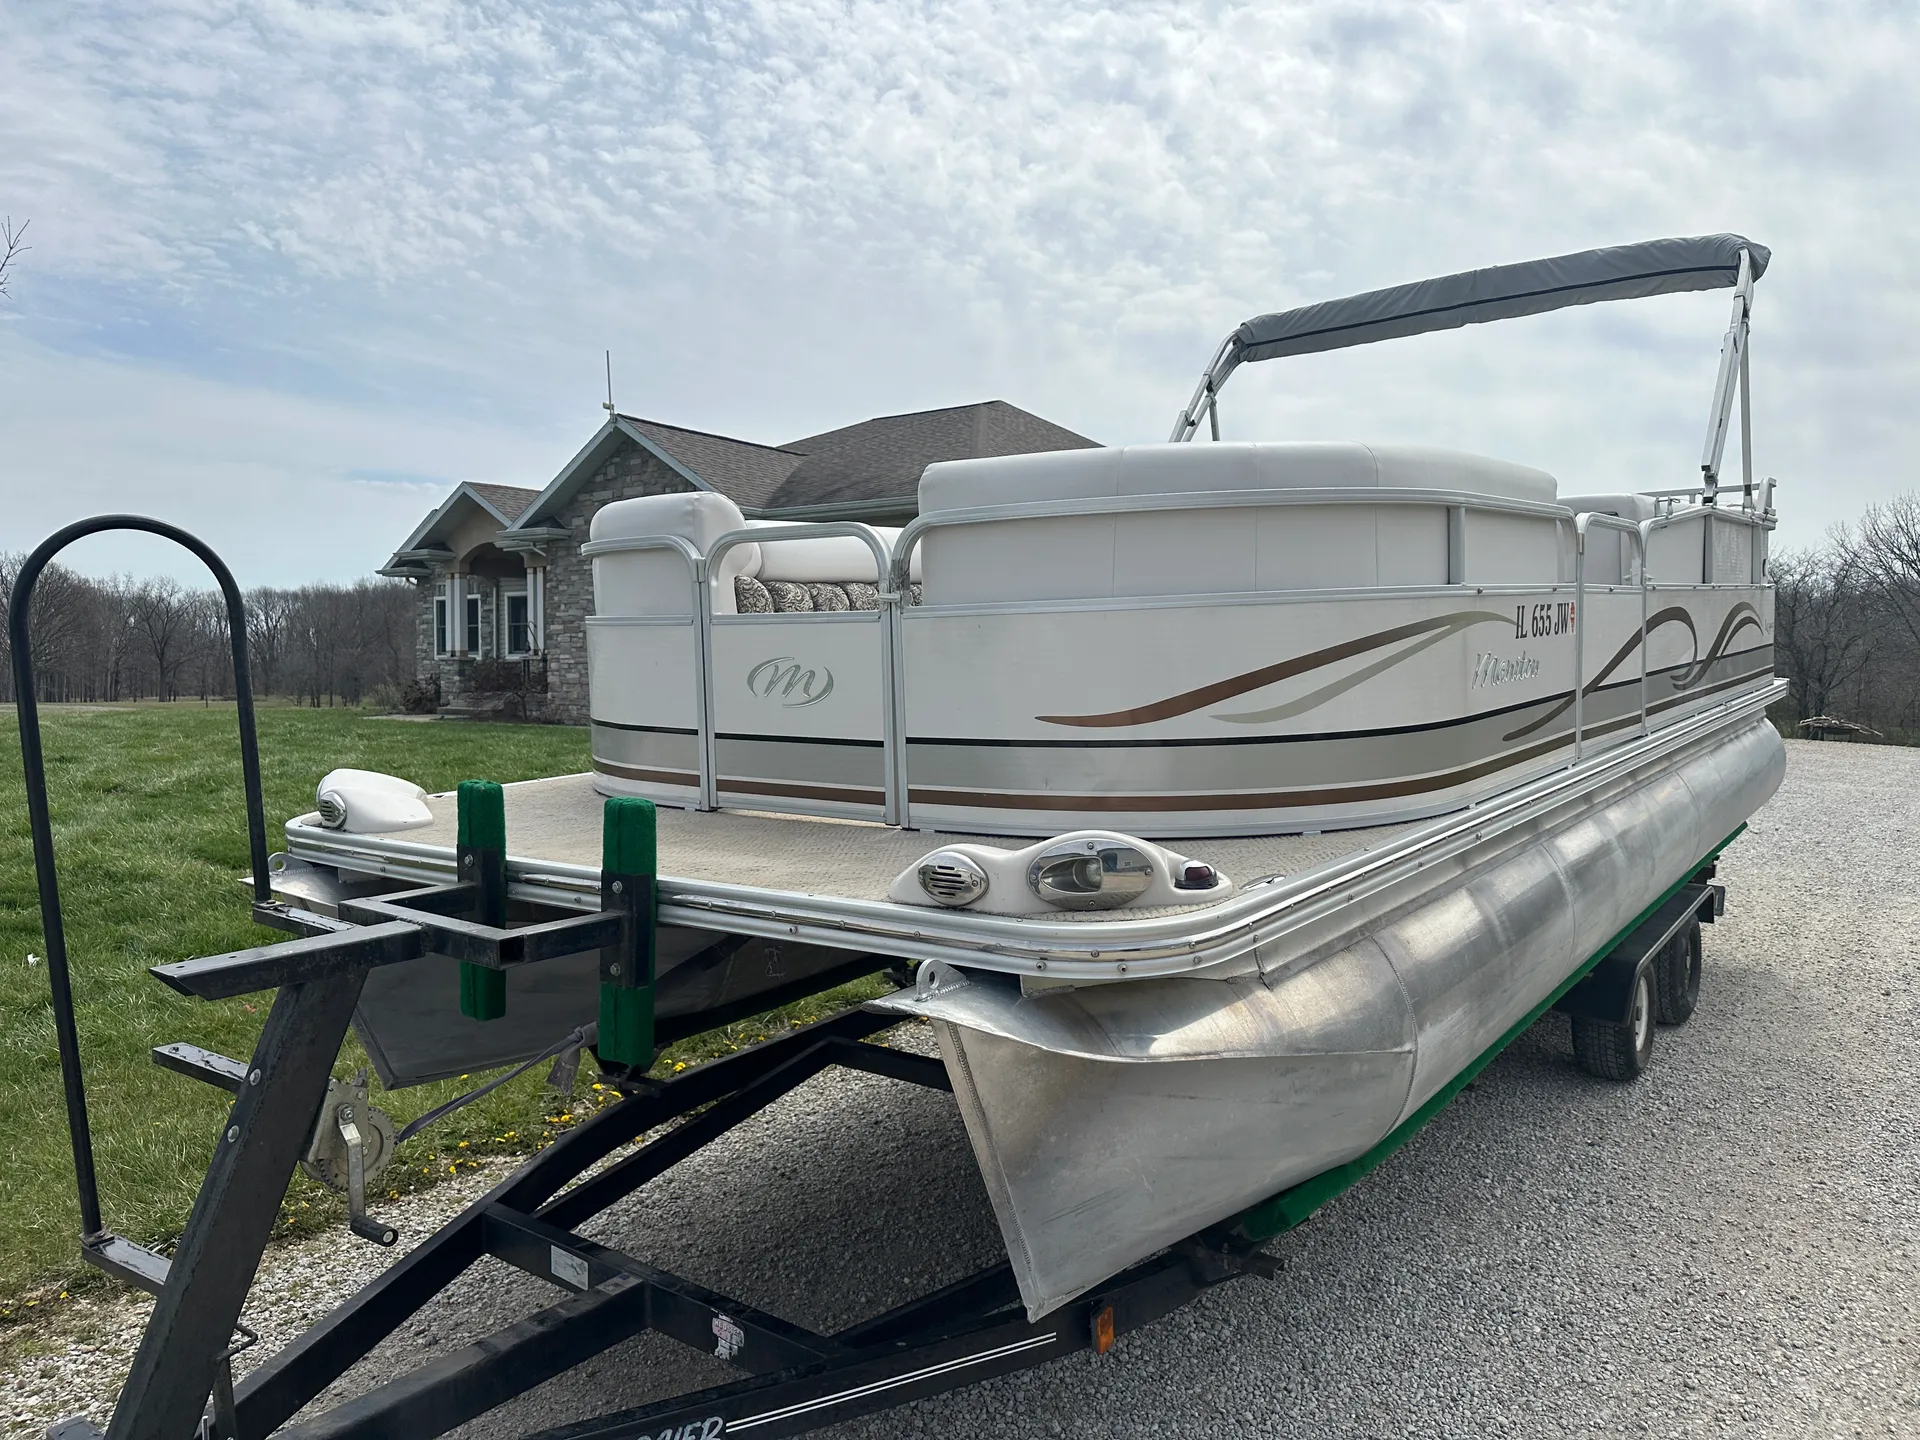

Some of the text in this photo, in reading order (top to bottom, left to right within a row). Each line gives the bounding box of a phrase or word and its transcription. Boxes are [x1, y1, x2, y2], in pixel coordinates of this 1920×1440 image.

[1515, 605, 1528, 639] IL
[1531, 603, 1552, 637] 655
[1554, 602, 1570, 635] JW
